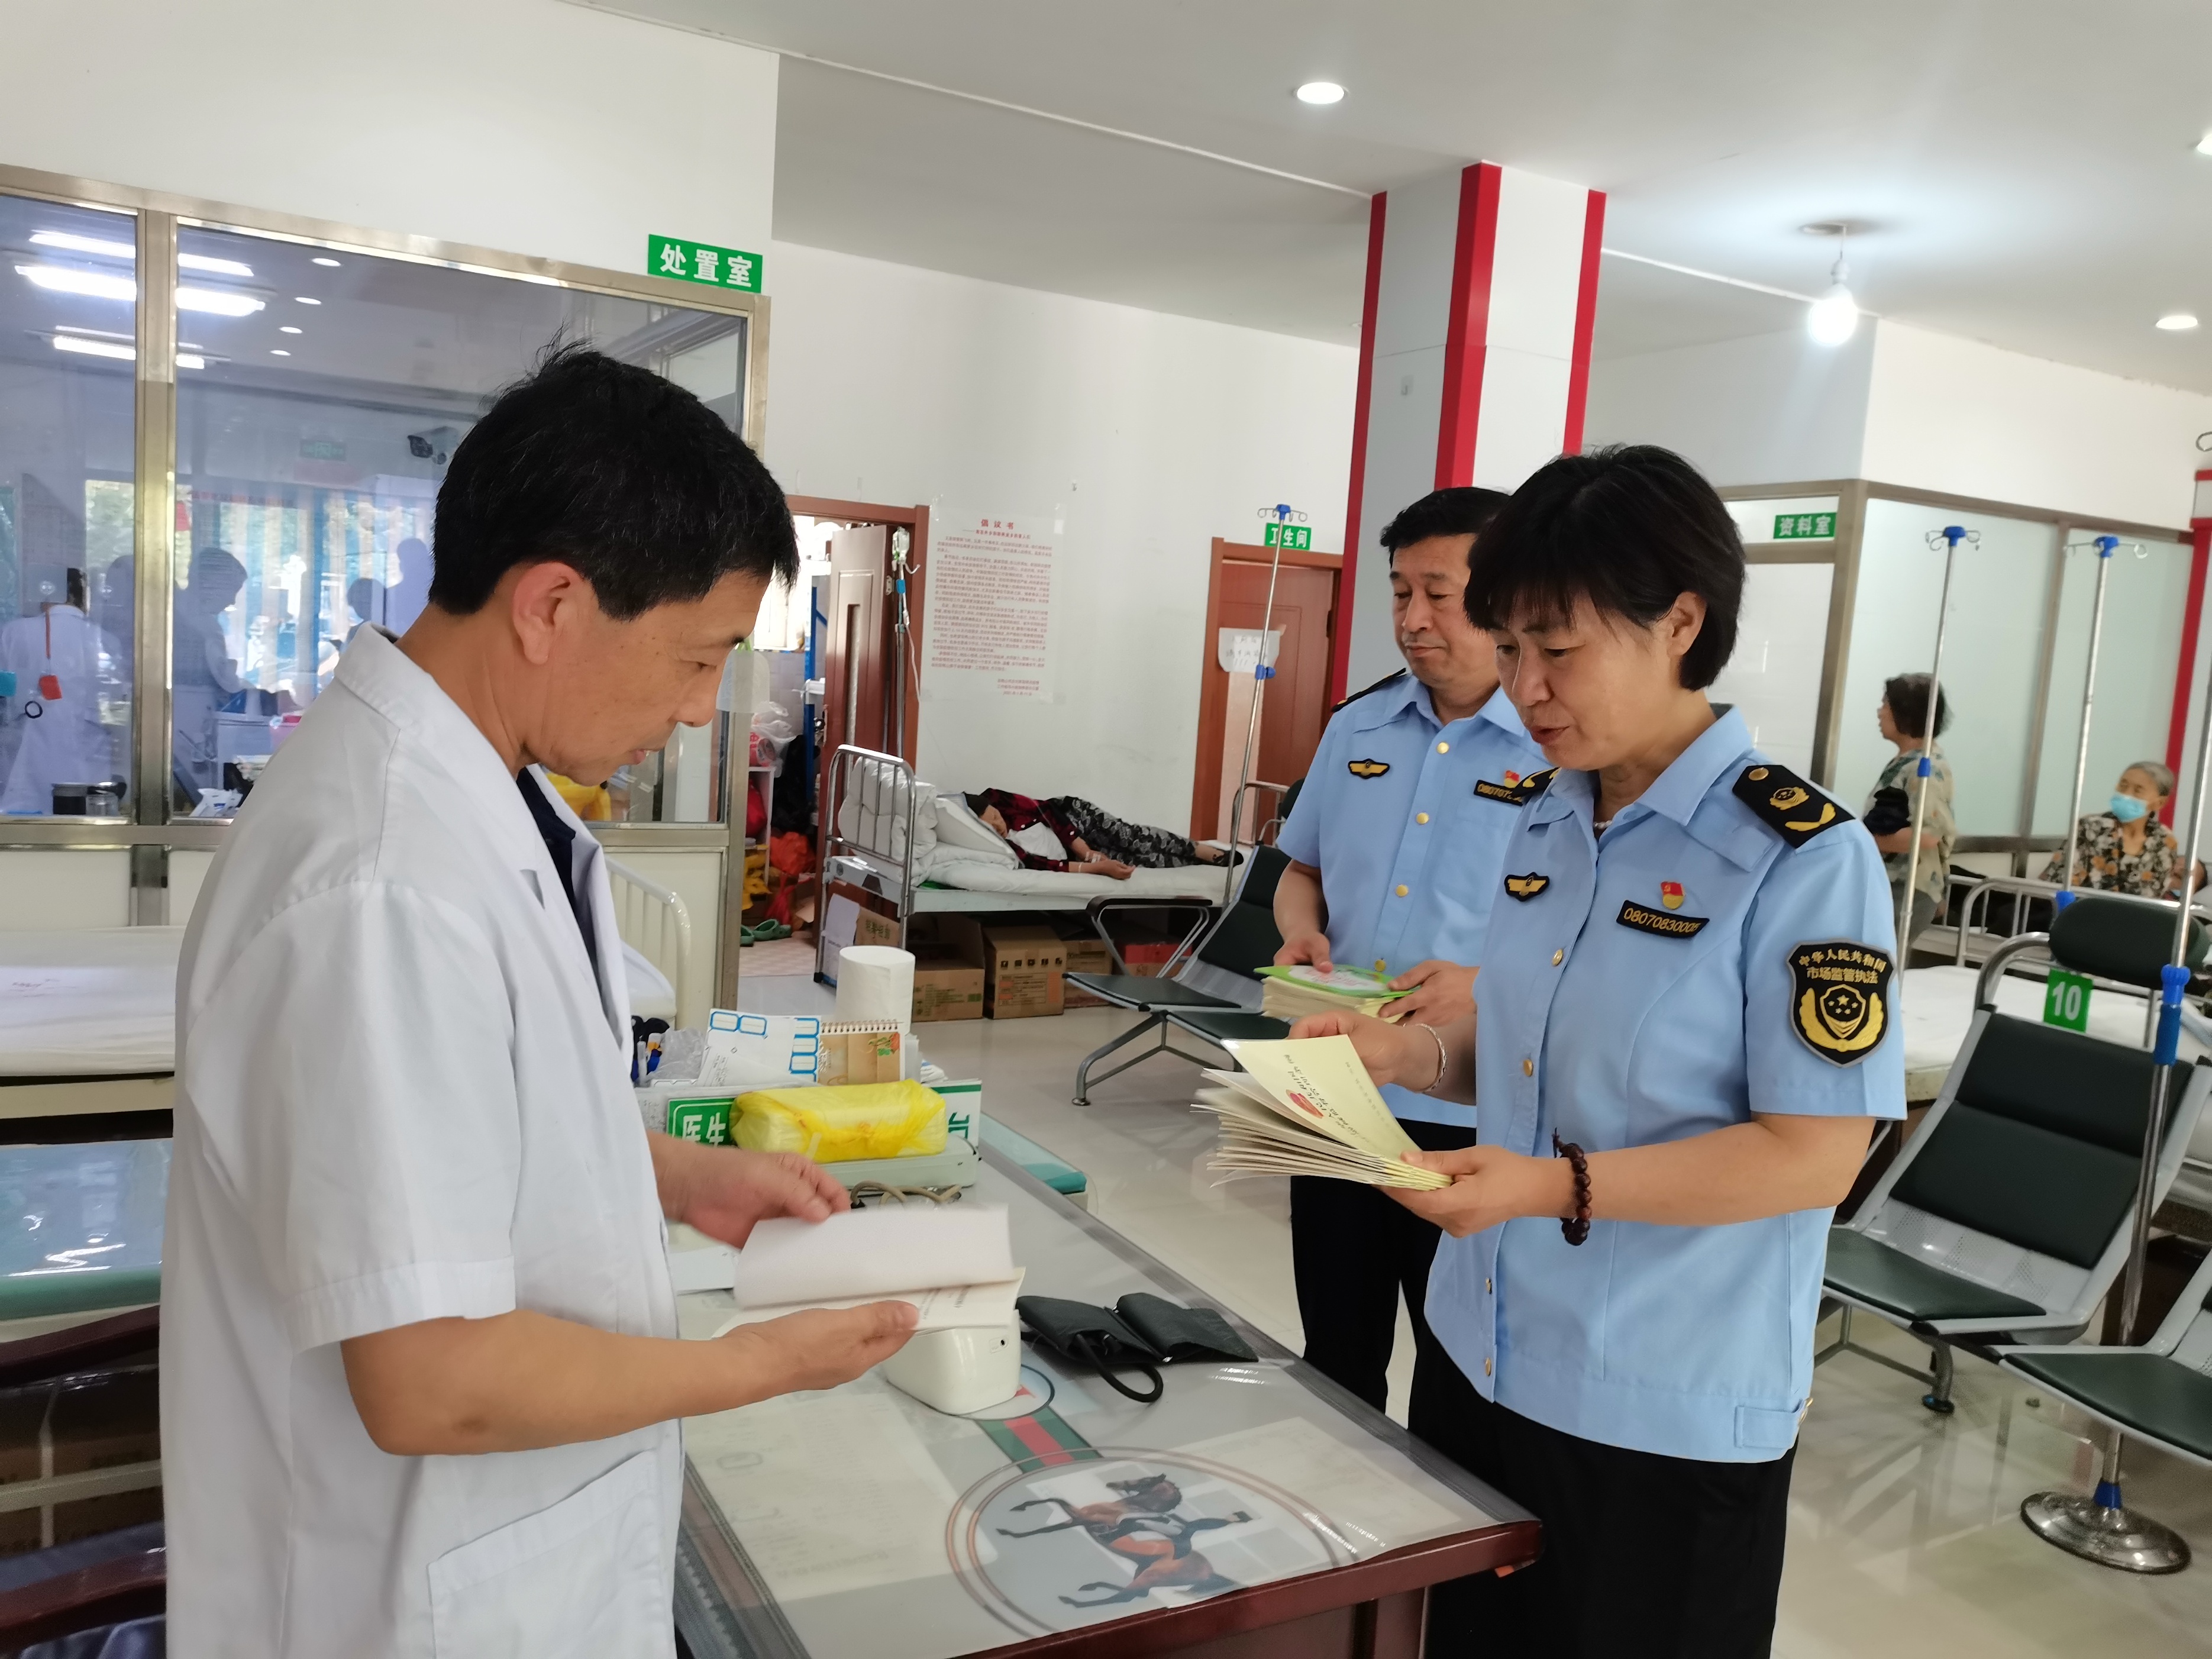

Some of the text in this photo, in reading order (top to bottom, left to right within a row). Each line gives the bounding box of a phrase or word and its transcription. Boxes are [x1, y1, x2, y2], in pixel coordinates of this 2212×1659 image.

[660, 243, 752, 287] 处置室
[1779, 515, 1831, 536] 资料室
[1798, 948, 1887, 973] 中华人民共和国
[1807, 966, 1878, 984] 市场监管执法
[2052, 982, 2081, 1020] 10
[682, 1112, 726, 1148] 医生
